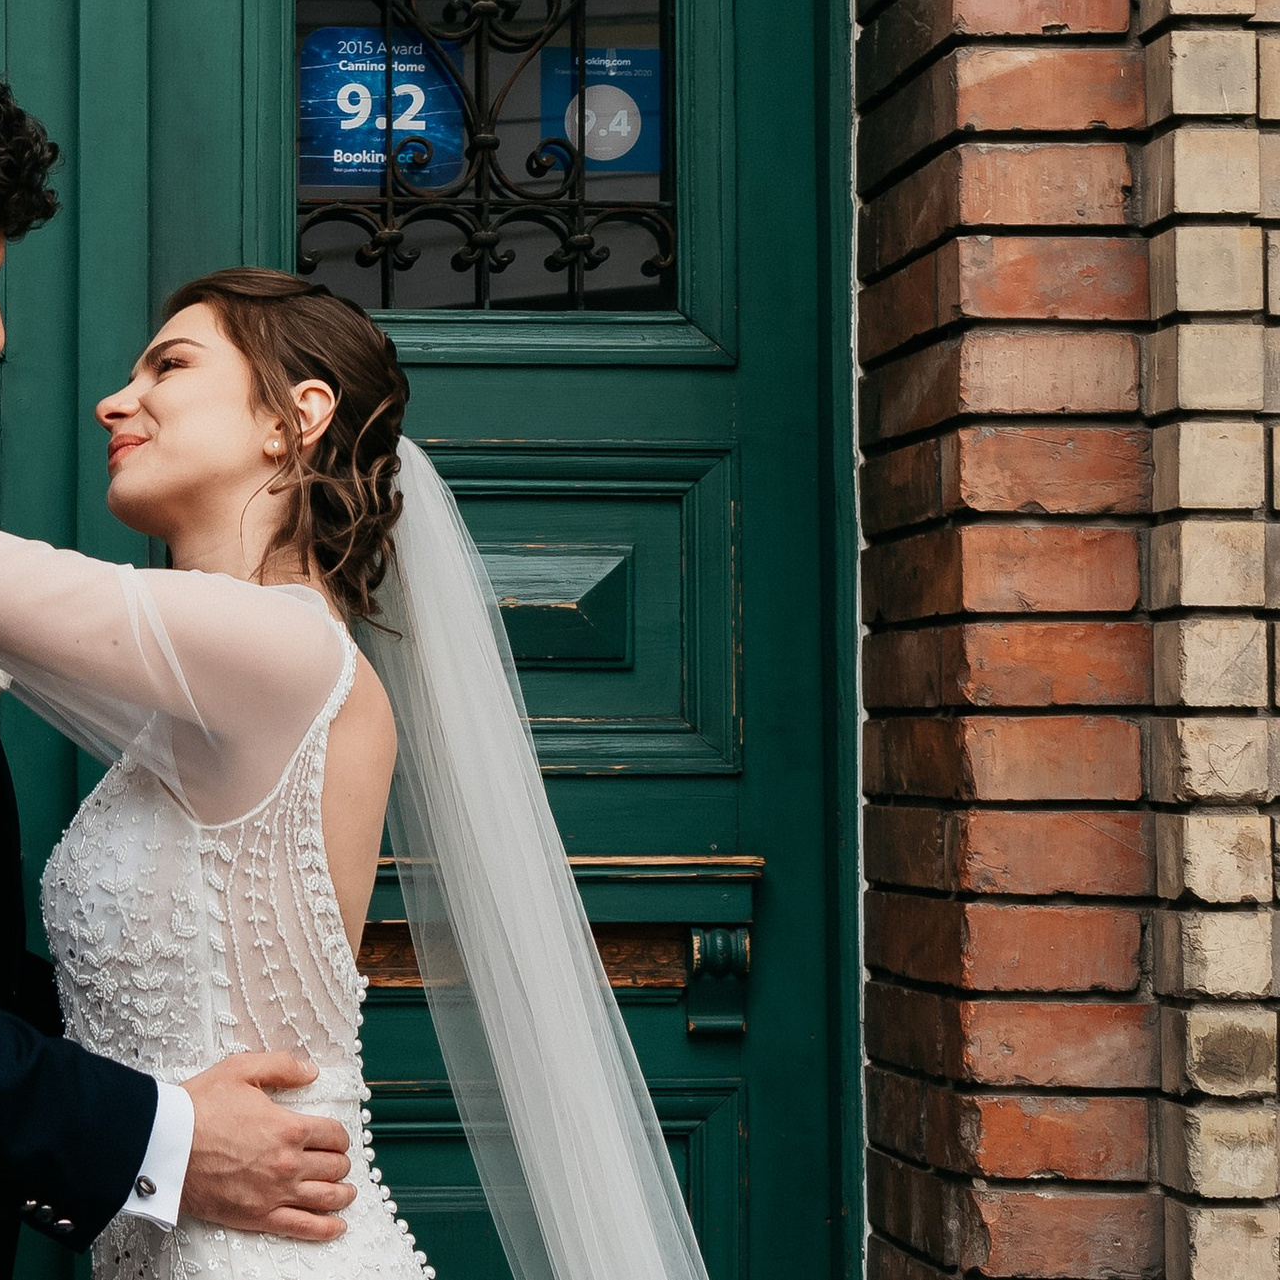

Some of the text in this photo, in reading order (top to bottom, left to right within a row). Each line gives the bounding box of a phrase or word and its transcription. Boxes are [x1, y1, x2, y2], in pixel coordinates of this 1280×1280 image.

[337, 41, 373, 55] 2015
[338, 60, 386, 72] Camino
[336, 83, 426, 131] 9.2
